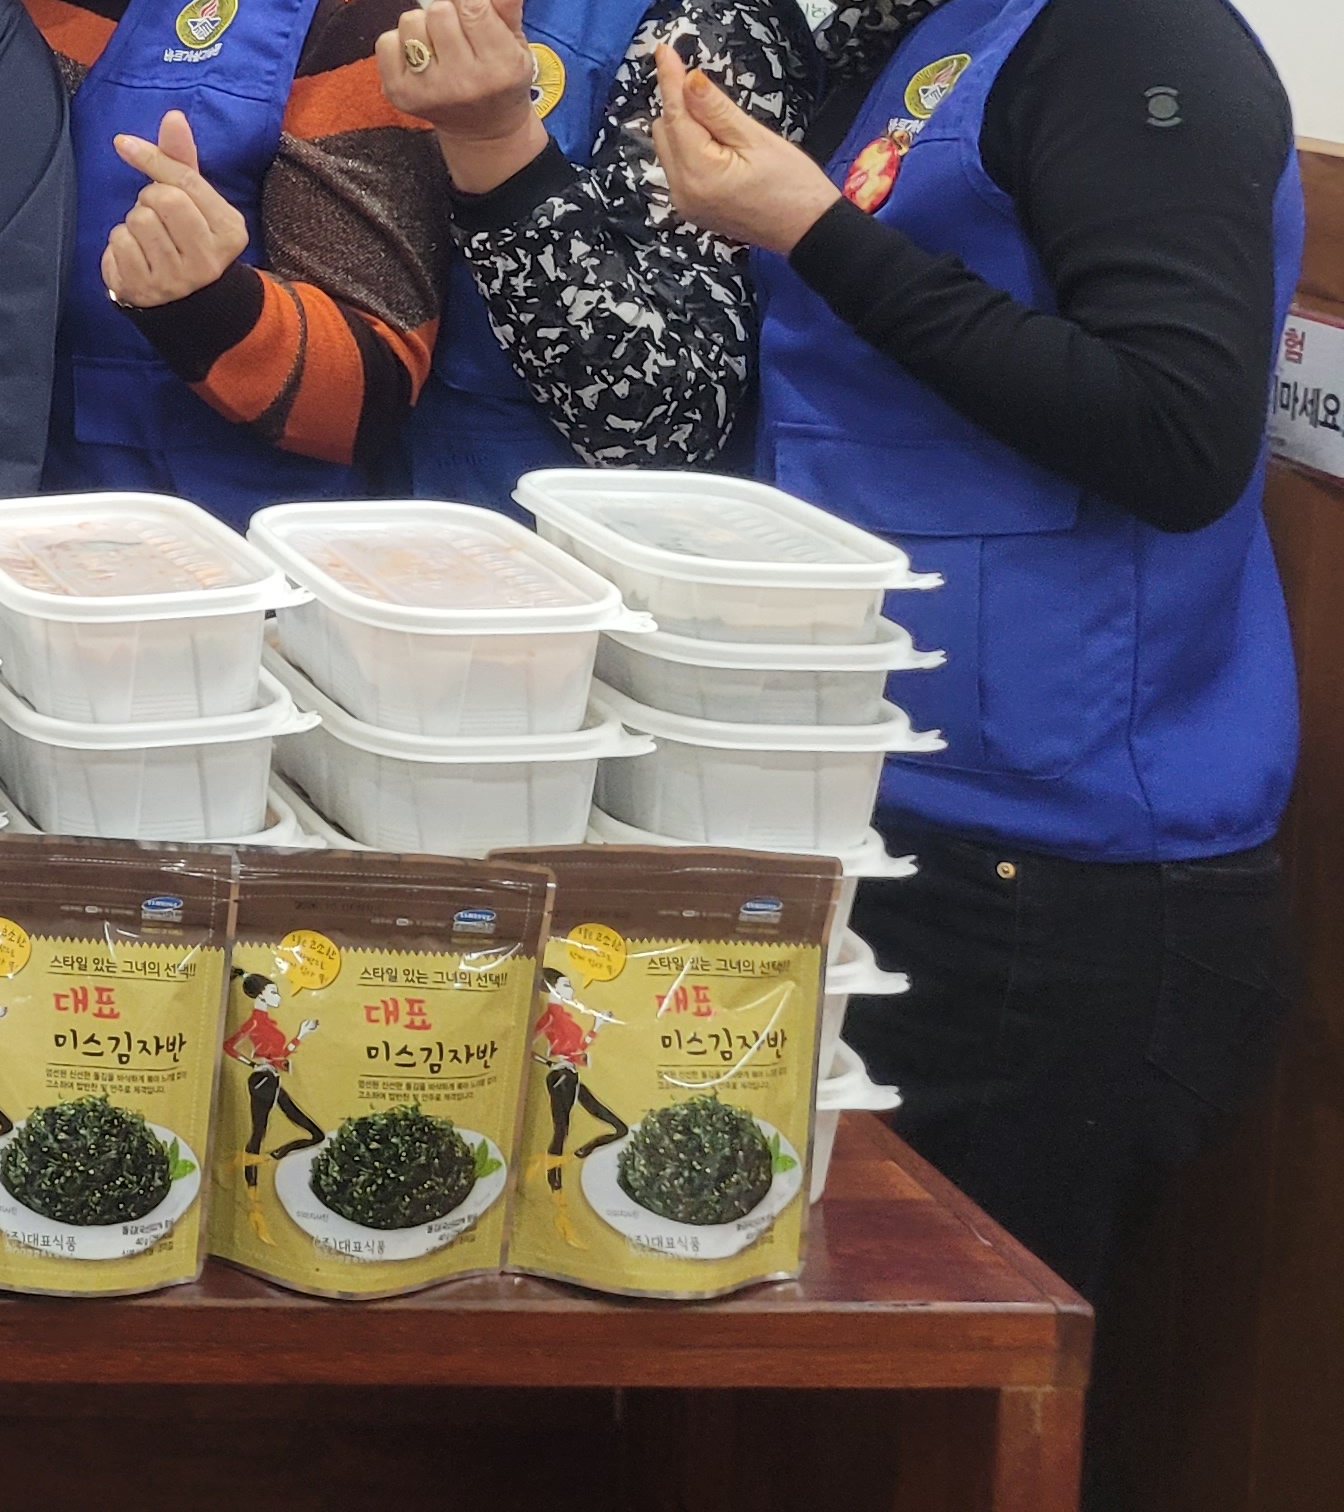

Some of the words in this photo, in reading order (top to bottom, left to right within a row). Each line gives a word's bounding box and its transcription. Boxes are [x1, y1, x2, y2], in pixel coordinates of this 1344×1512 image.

[50, 955, 87, 972] 스타일
[93, 957, 118, 974] 있는
[121, 960, 161, 977] 그녀의
[360, 967, 398, 983] 스타일
[403, 968, 429, 984] 있는
[432, 971, 472, 988] 그녀의
[475, 972, 509, 988] 선택!!
[647, 956, 684, 972] 스타일
[716, 958, 755, 974] 그녀의
[53, 986, 120, 1019] 대표
[363, 997, 432, 1030] 대표
[655, 985, 713, 1017] 대표
[54, 1028, 187, 1065] 미스김자반
[366, 1040, 499, 1074] 미스김자반
[661, 1028, 788, 1062] 미스김자반
[3, 1230, 77, 1253] (주)대표식품
[313, 1236, 386, 1255] (주)대표식품
